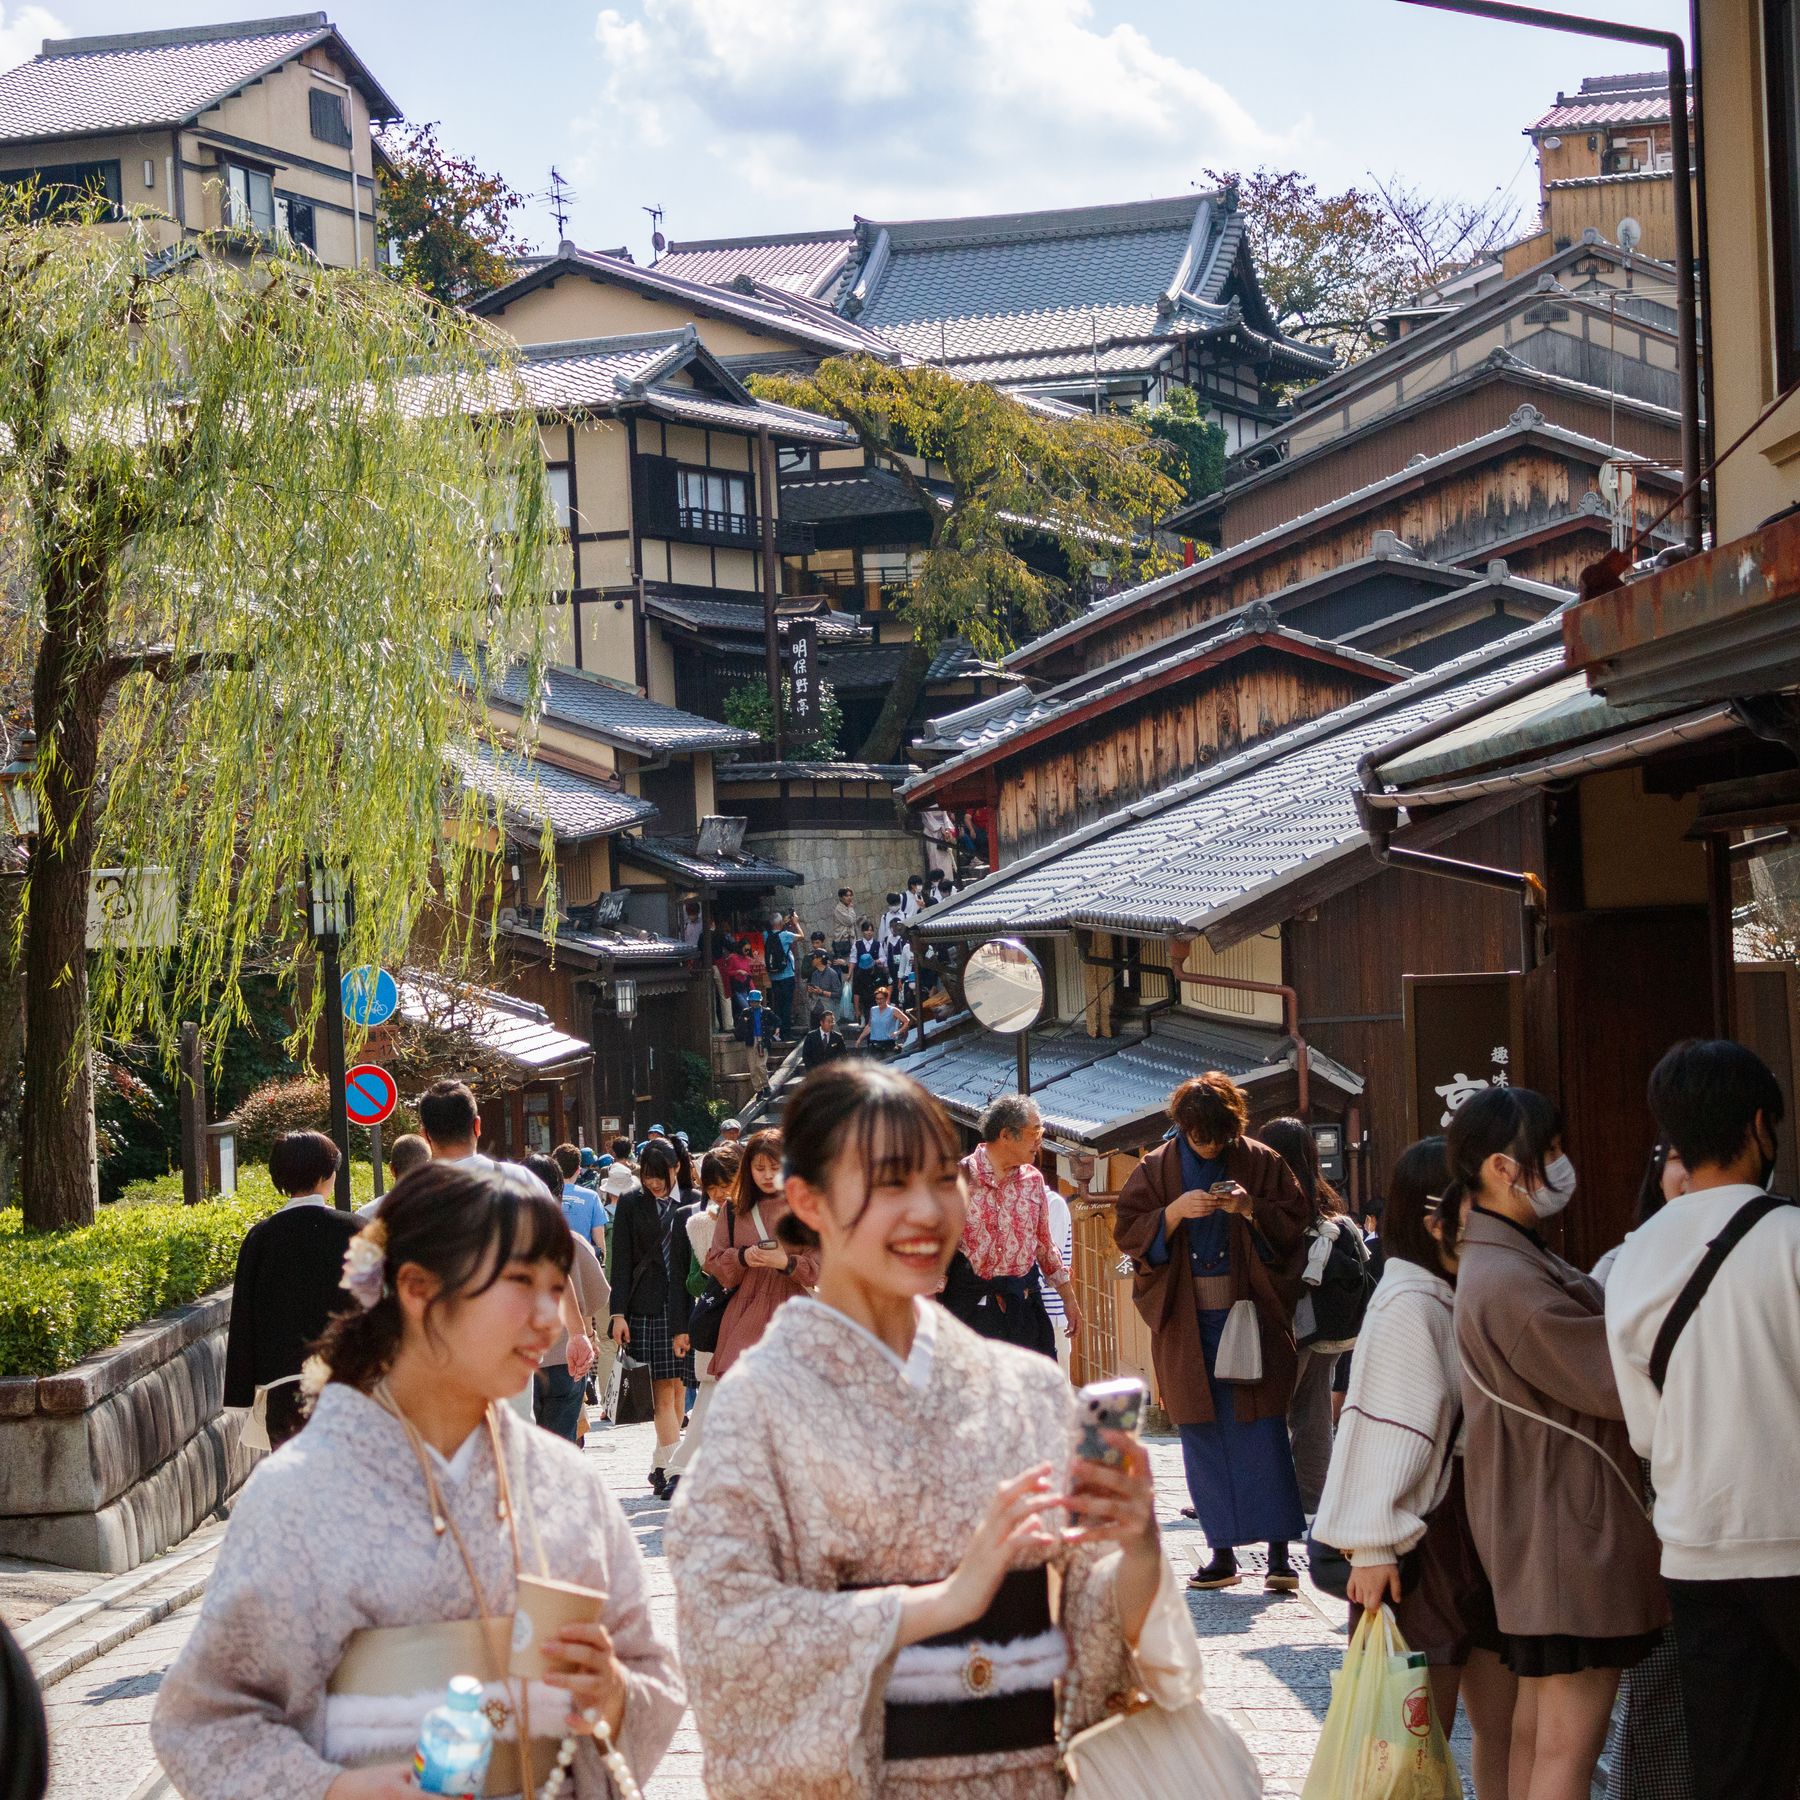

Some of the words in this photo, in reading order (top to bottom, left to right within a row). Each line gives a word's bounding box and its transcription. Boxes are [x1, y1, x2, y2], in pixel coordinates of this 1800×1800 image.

[792, 638, 809, 717] 明保野亭
[1490, 1046, 1509, 1089] 趣味
[1115, 1253, 1134, 1275] 茶
